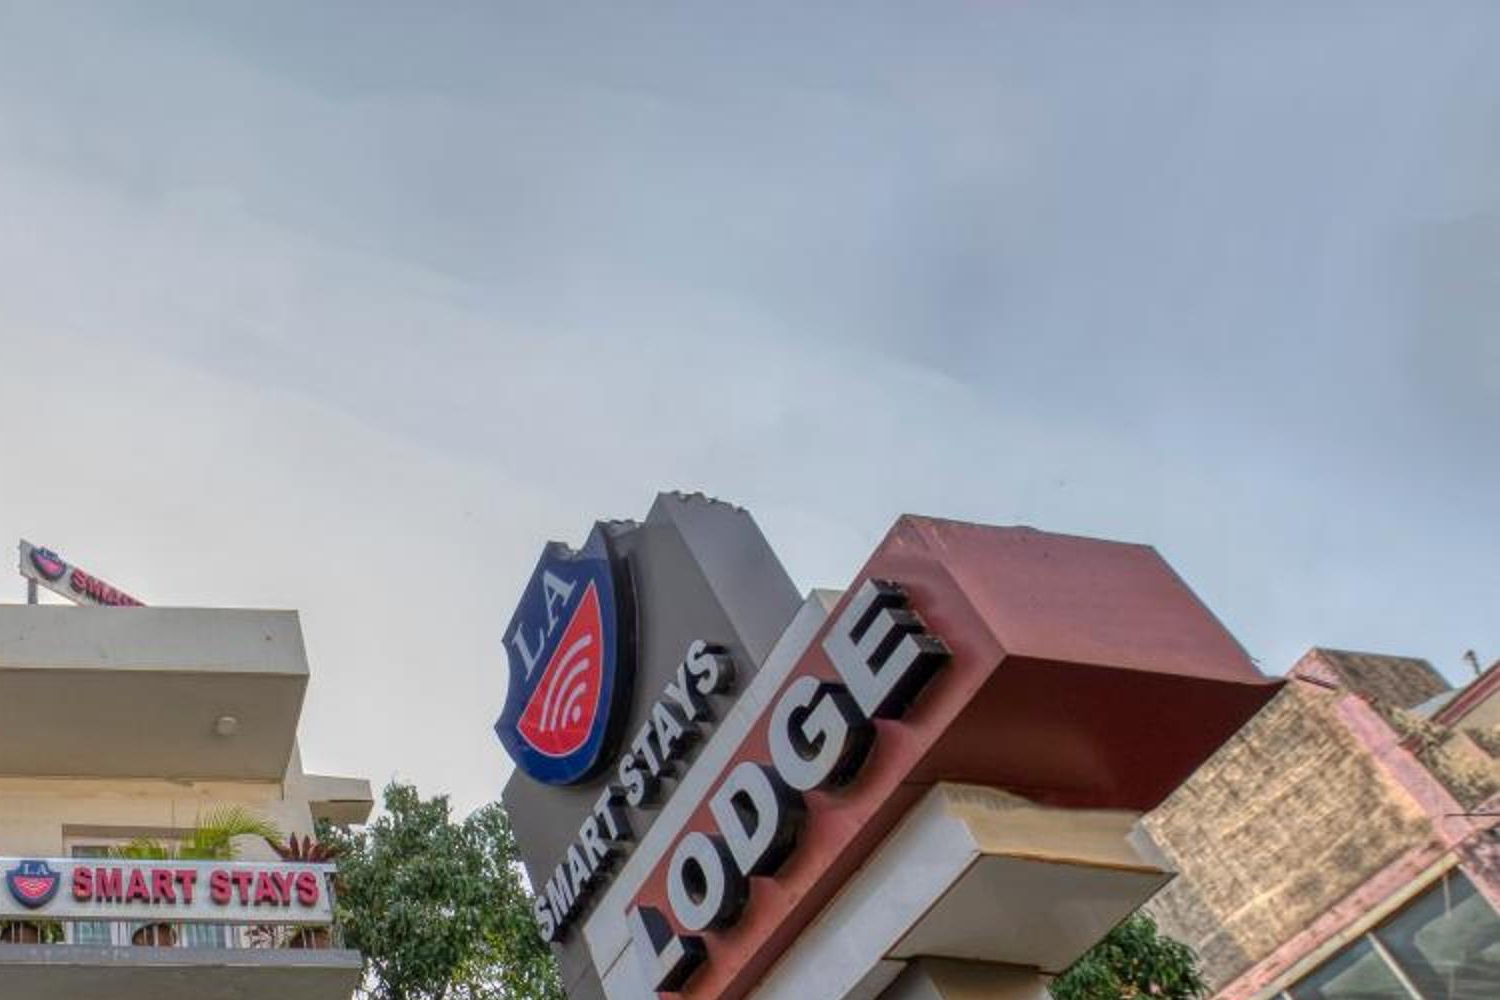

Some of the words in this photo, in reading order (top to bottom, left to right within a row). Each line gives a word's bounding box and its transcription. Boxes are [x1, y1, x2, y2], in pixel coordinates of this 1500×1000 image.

[511, 569, 577, 683] LA
[72, 867, 197, 903] SMART
[210, 869, 320, 907] STAYS
[534, 785, 621, 943] SMART
[619, 639, 720, 807] STAYS
[626, 577, 924, 993] LODGE
